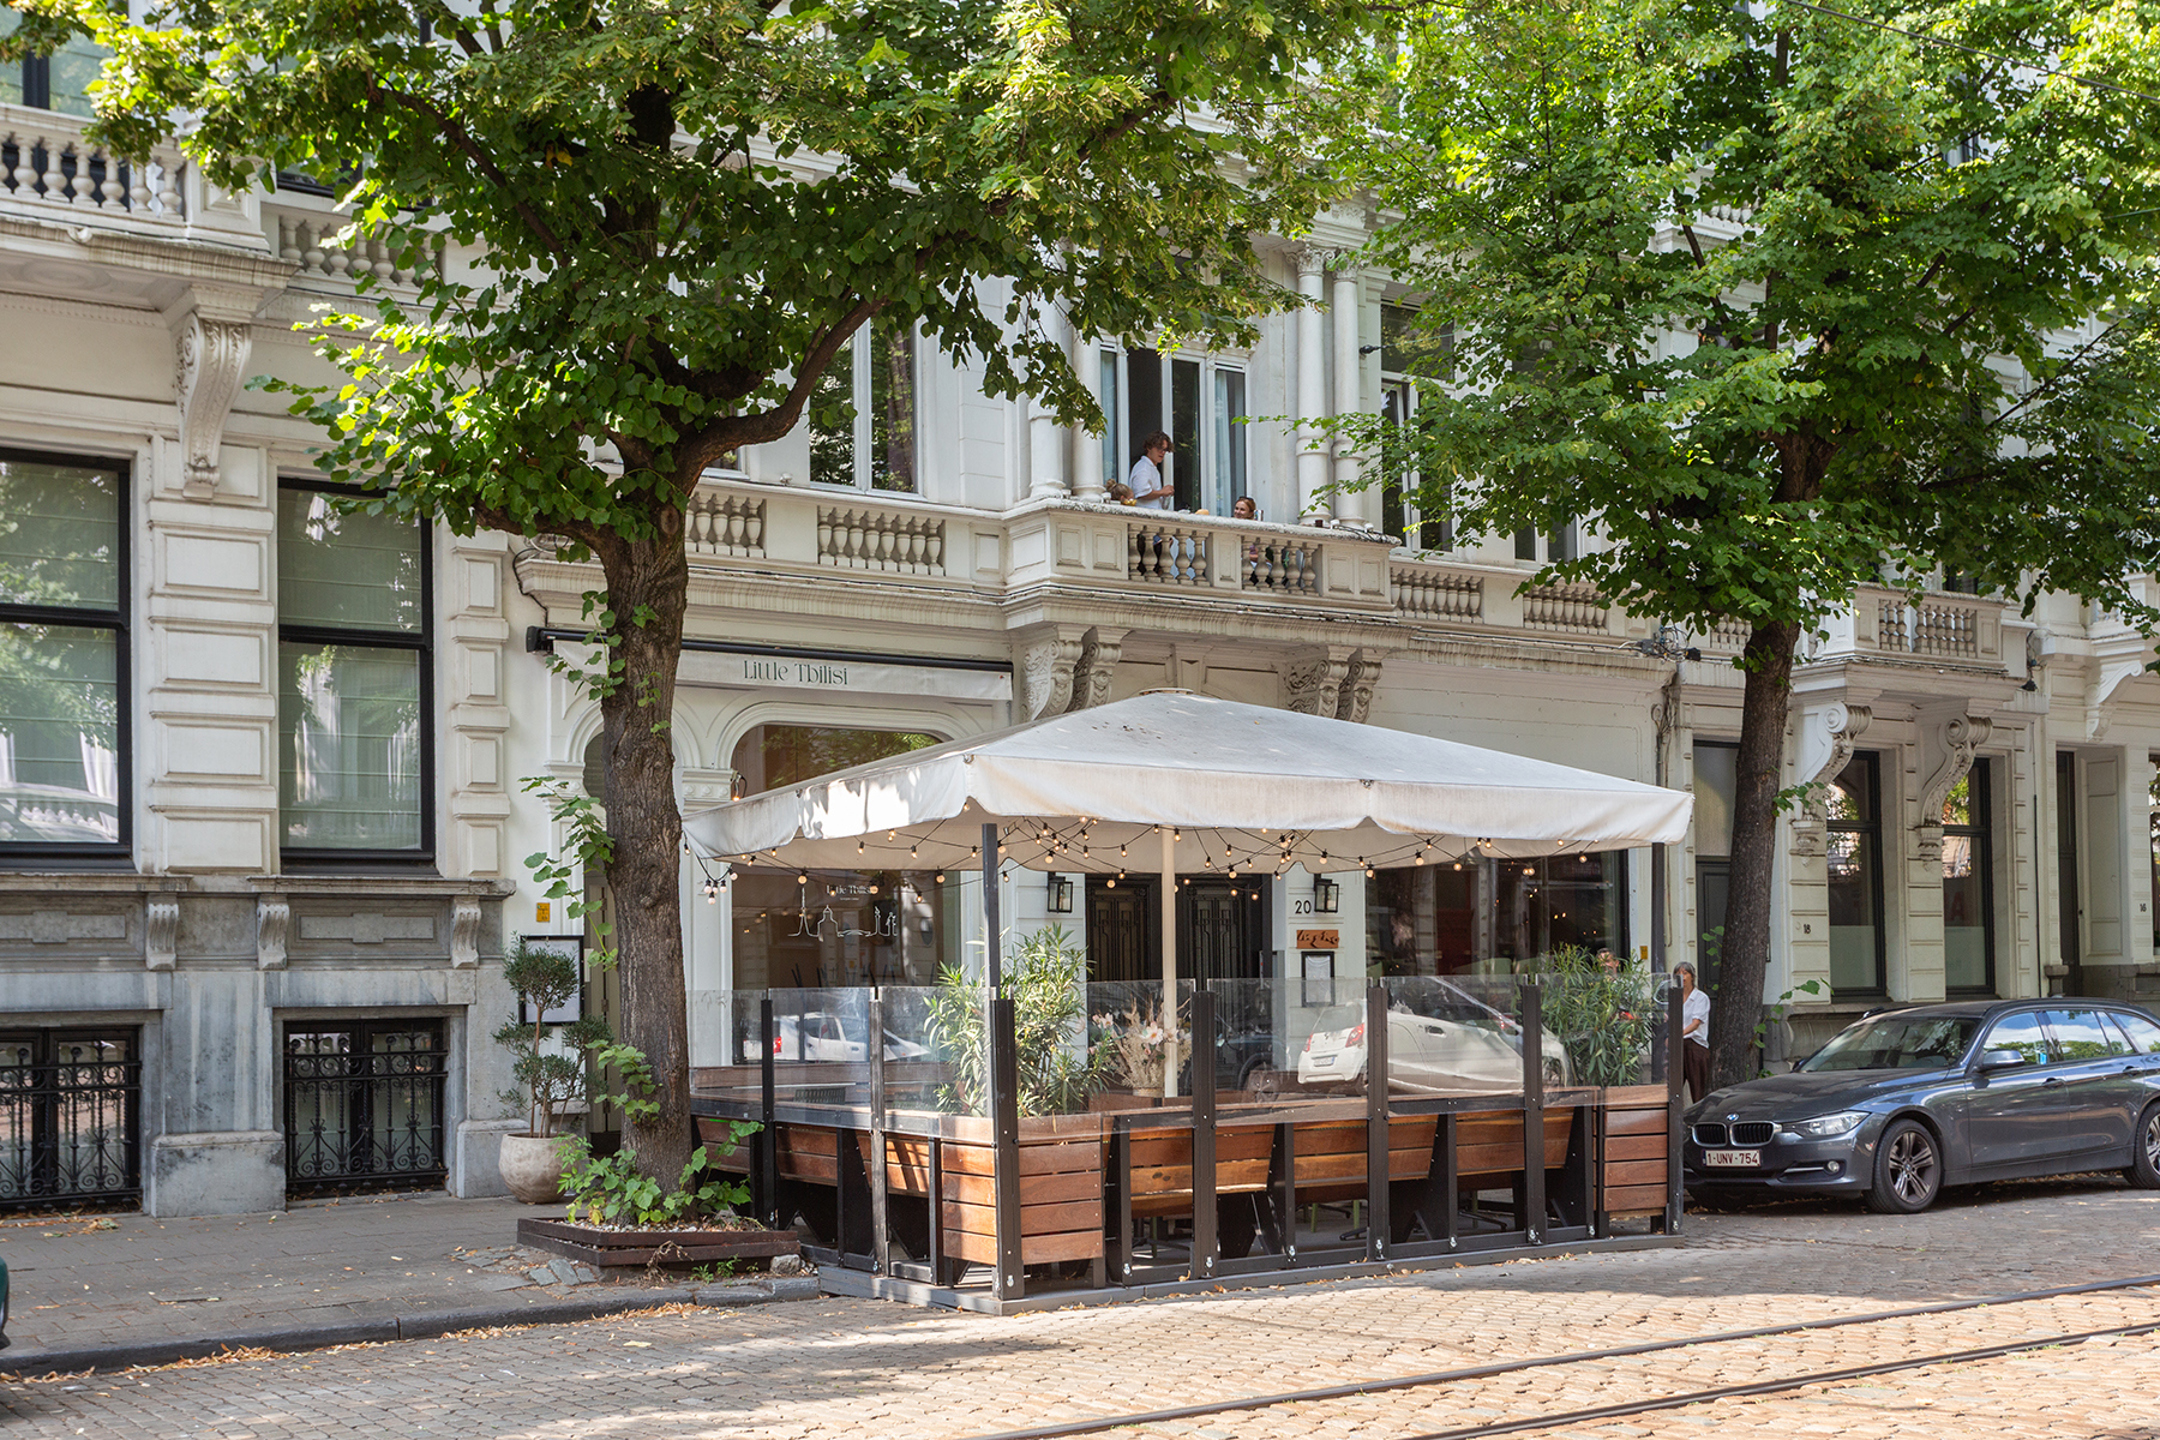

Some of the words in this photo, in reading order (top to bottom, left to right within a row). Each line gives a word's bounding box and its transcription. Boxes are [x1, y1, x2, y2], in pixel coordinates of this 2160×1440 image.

[744, 660, 788, 681] Little
[794, 663, 848, 685] Tbilisi
[1295, 900, 1312, 914] 20
[1803, 924, 1811, 934] 18
[1707, 1153, 1758, 1164] 1-UNV-754
